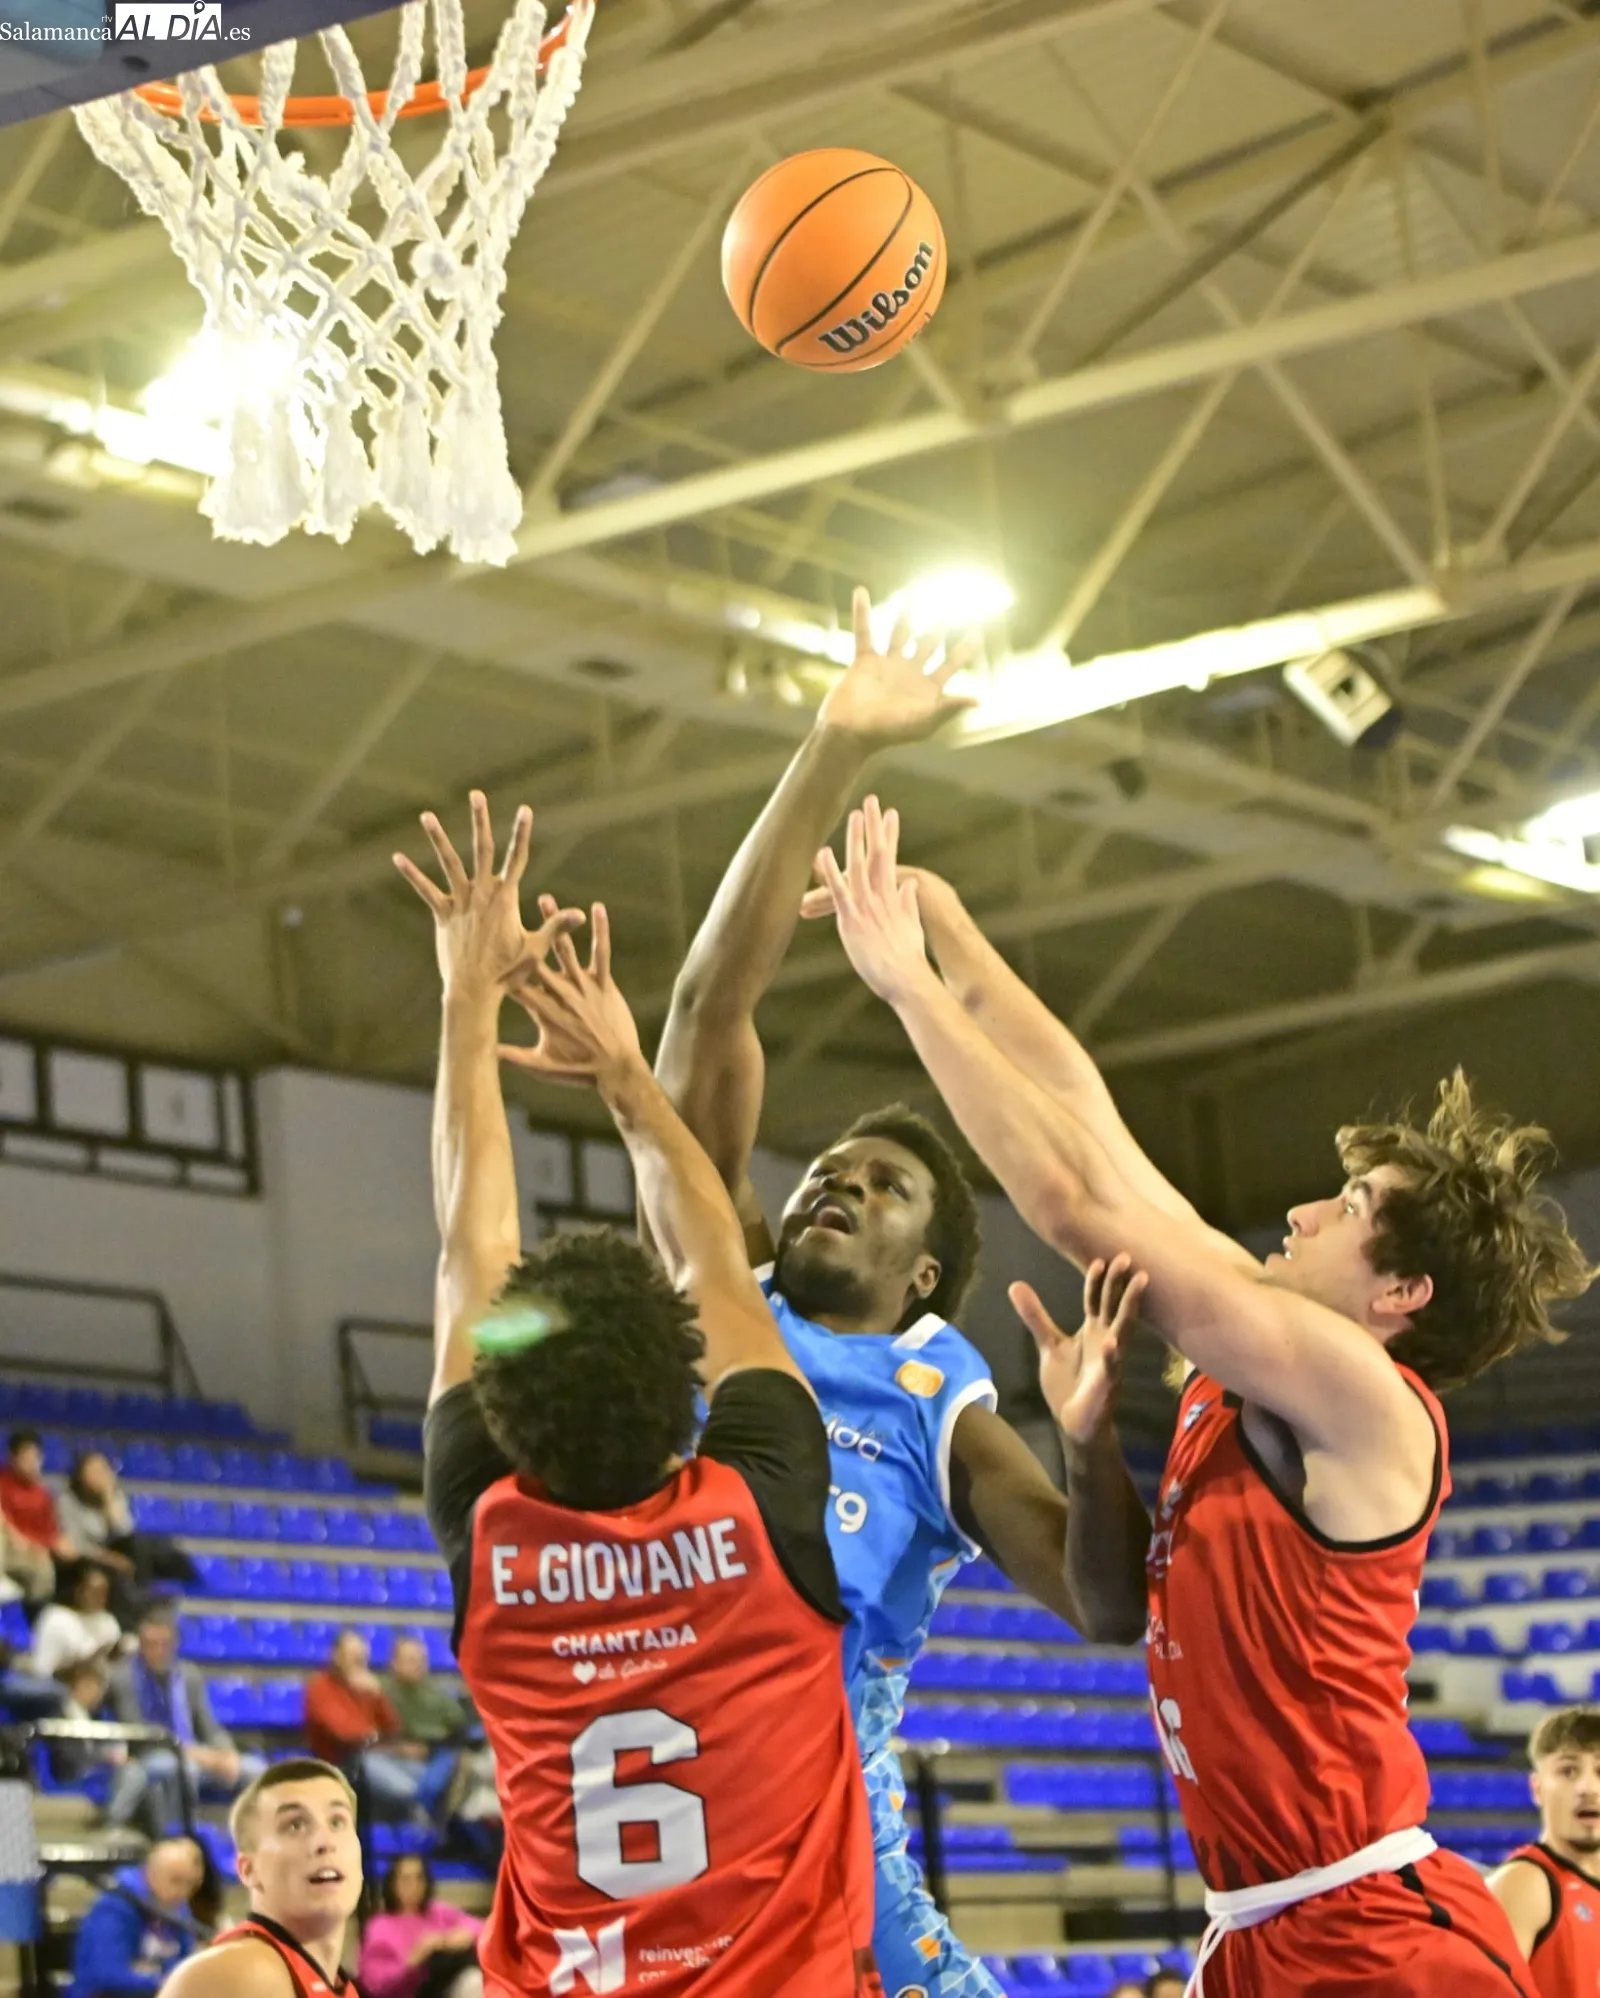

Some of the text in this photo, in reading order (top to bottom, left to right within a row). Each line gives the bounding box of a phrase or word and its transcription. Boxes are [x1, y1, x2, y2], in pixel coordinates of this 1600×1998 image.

[817, 241, 933, 353] Wilson
[491, 1517, 747, 1606] E.GIOVANE
[552, 1623, 697, 1658] CHANTADA
[570, 1707, 711, 1901] 6
